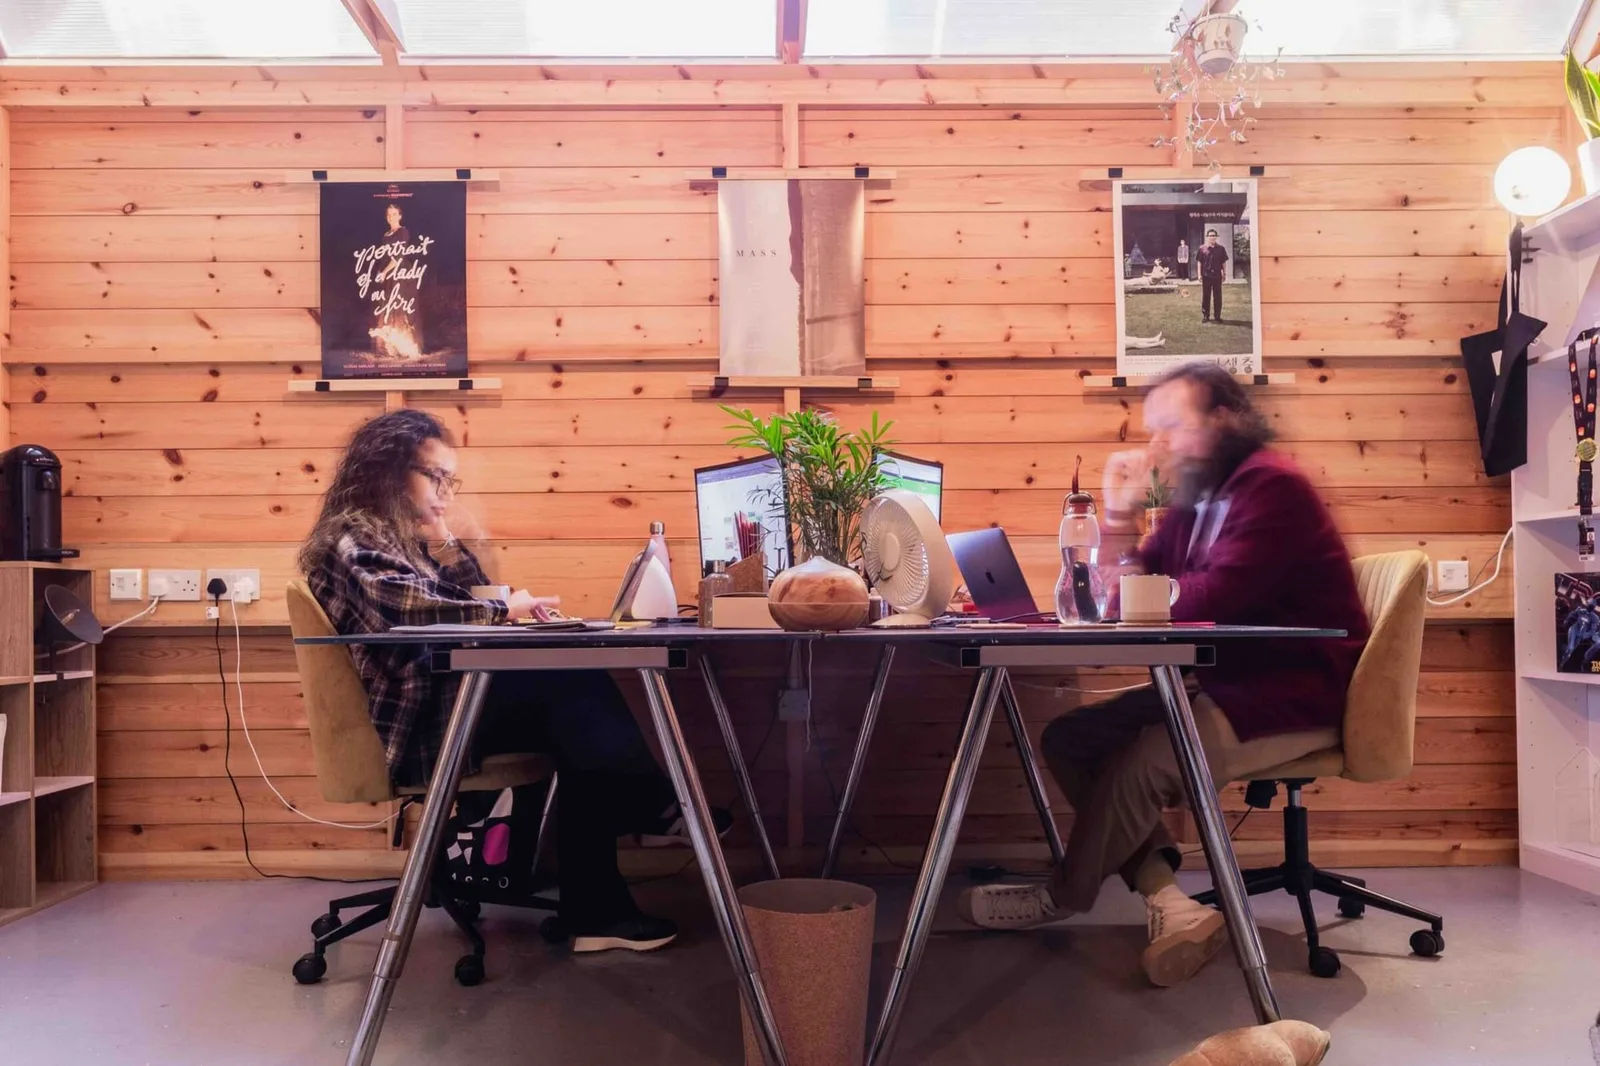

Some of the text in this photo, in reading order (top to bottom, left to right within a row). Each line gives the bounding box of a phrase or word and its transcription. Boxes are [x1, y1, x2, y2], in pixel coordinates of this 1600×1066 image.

[353, 235, 435, 274] portrait
[736, 249, 777, 257] MASS
[356, 259, 376, 299] of
[386, 256, 428, 290] lady
[373, 282, 416, 324] fire
